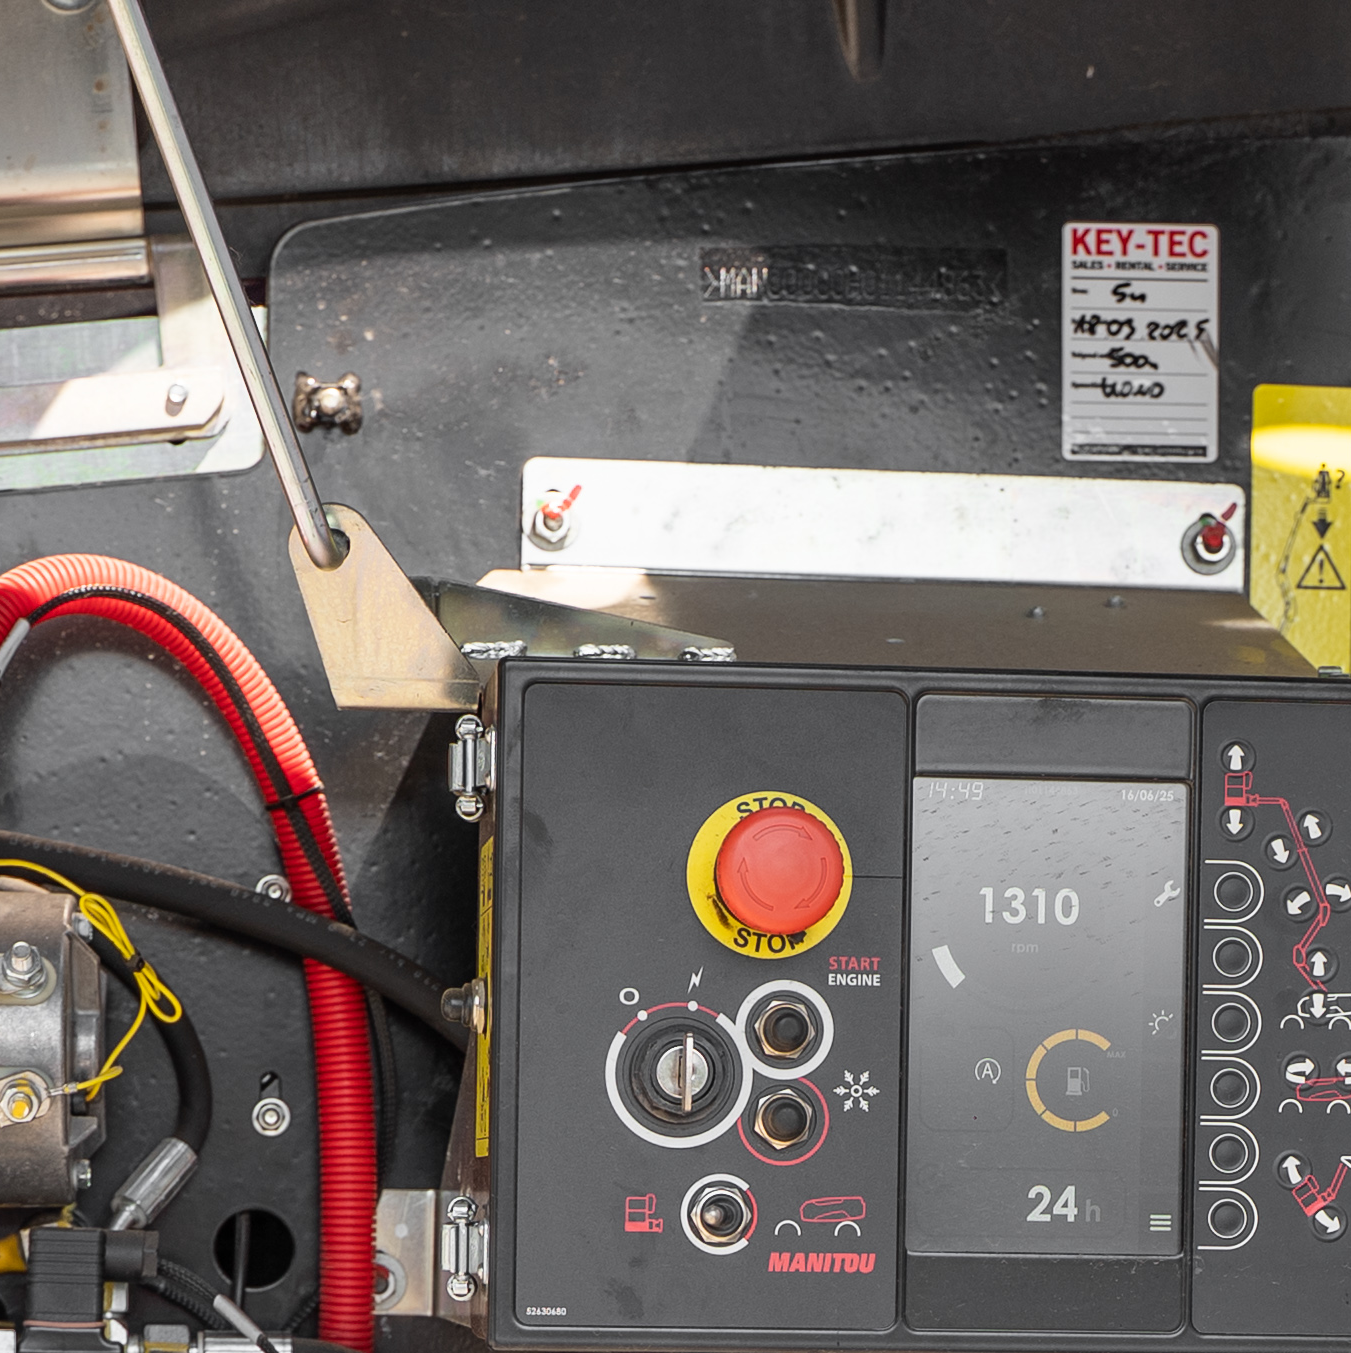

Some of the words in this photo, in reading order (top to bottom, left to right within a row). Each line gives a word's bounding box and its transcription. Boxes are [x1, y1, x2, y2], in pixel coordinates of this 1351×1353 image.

[1071, 228, 1209, 259] KEY-TEC
[1071, 261, 1104, 270] SALES
[1115, 262, 1155, 271] RENTAL
[1165, 263, 1208, 272] SERVICE
[928, 781, 984, 800] 14:49
[1120, 788, 1175, 802] 16/06/25
[979, 886, 1080, 926] 1310
[1011, 941, 1039, 955] rpm
[828, 956, 881, 971] START
[827, 973, 881, 986] ENGINE
[1106, 1050, 1127, 1059] MAX
[1026, 1184, 1078, 1222] 24
[1084, 1199, 1101, 1222] h
[768, 1251, 877, 1275] MANITOU
[525, 1306, 568, 1317] 52630680
